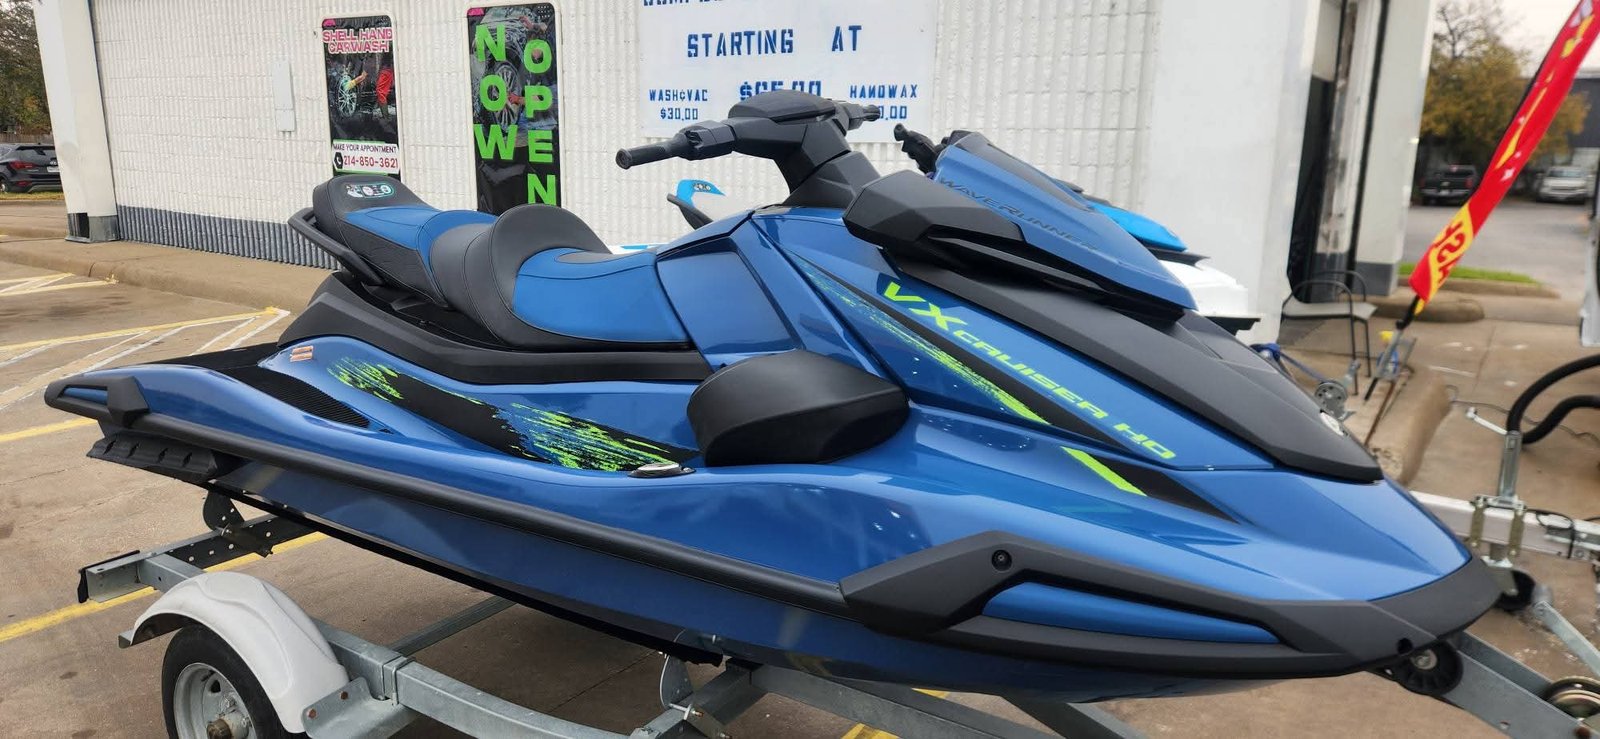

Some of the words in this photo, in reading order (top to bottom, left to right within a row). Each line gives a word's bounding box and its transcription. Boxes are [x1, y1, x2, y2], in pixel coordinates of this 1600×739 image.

[322, 29, 358, 43] SHELL
[359, 27, 393, 41] HAND
[687, 28, 794, 57] STARTING
[831, 25, 862, 52] AT
[328, 40, 390, 54] CARWASH
[473, 24, 519, 161] NOW
[523, 38, 557, 206] OPEN
[660, 107, 699, 121] $30.00
[333, 143, 345, 151] MAKE
[360, 145, 397, 154] APPOINTMENT
[343, 155, 399, 169] 214-850-3621
[884, 281, 968, 331] VX
[953, 329, 1109, 420] CRUISER
[1112, 422, 1177, 460] HO
